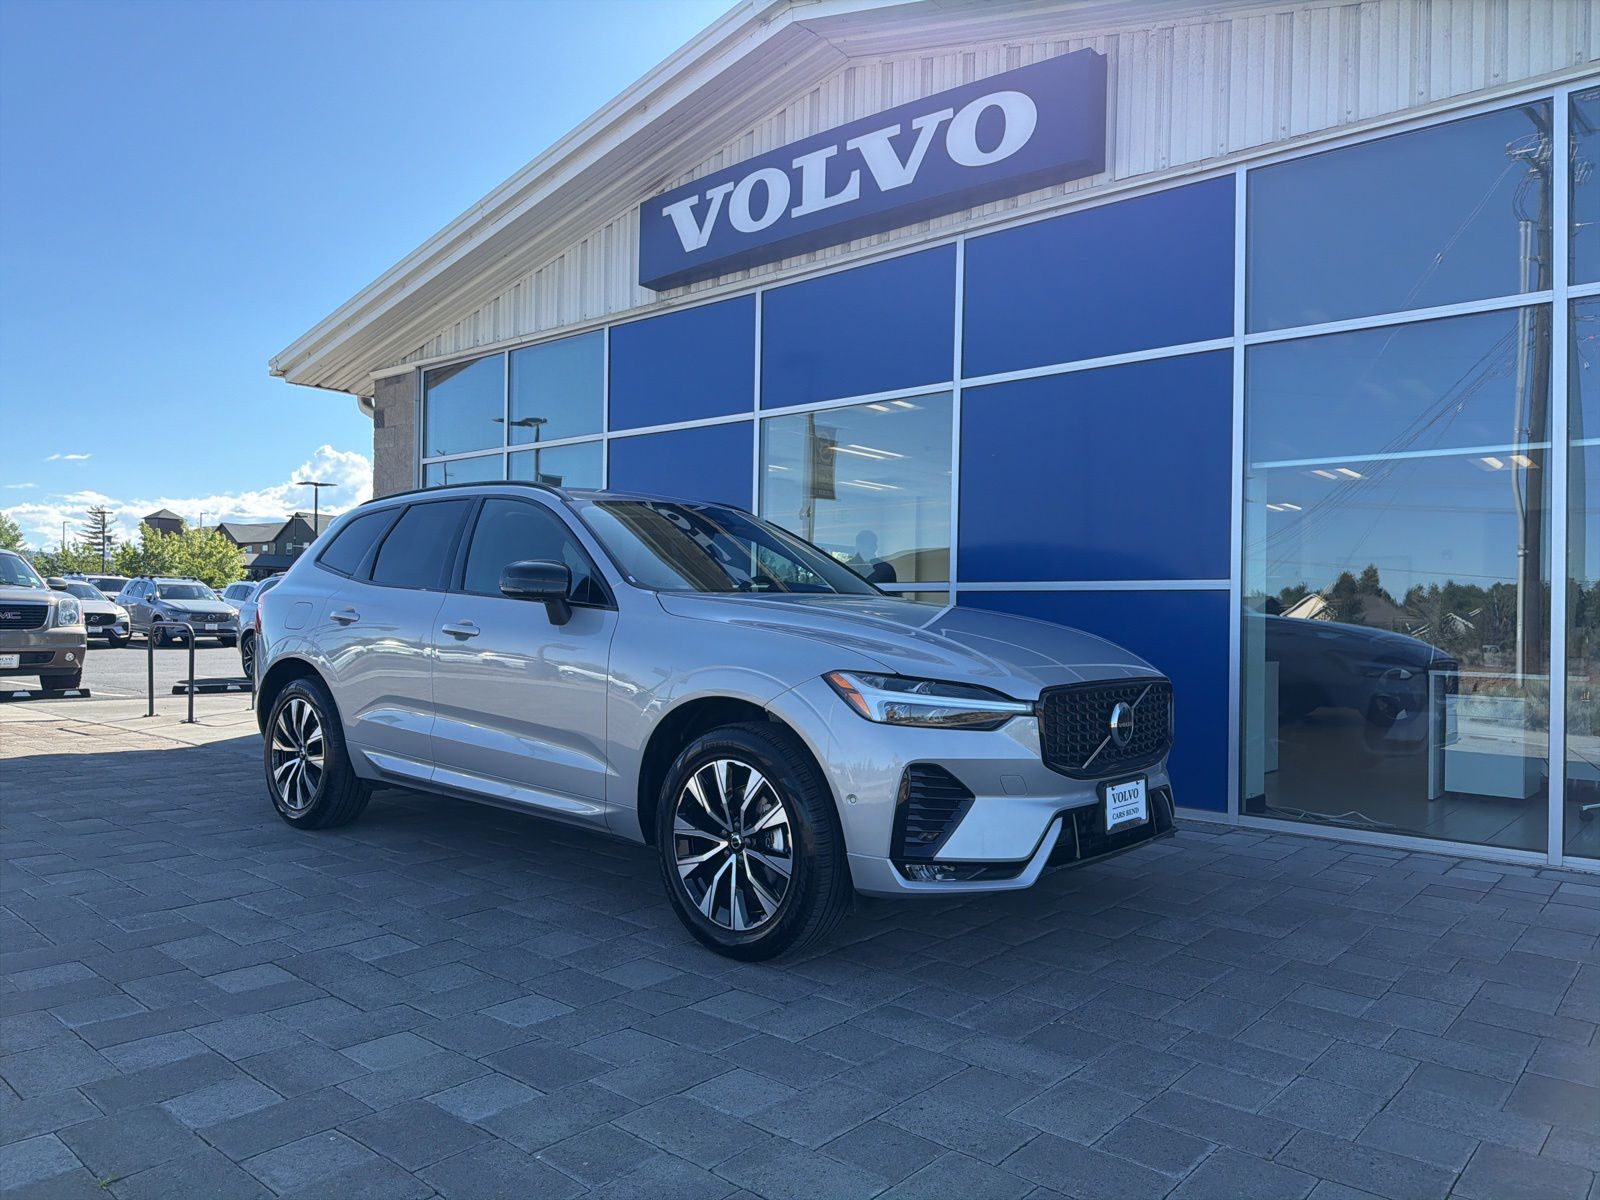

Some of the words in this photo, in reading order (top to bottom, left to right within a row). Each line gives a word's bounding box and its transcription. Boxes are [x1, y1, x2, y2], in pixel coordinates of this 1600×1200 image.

[662, 91, 1037, 253] VOLVO
[1112, 788, 1139, 804] VOLVO
[1112, 811, 1126, 820] CARS
[1125, 807, 1139, 816] BEND
